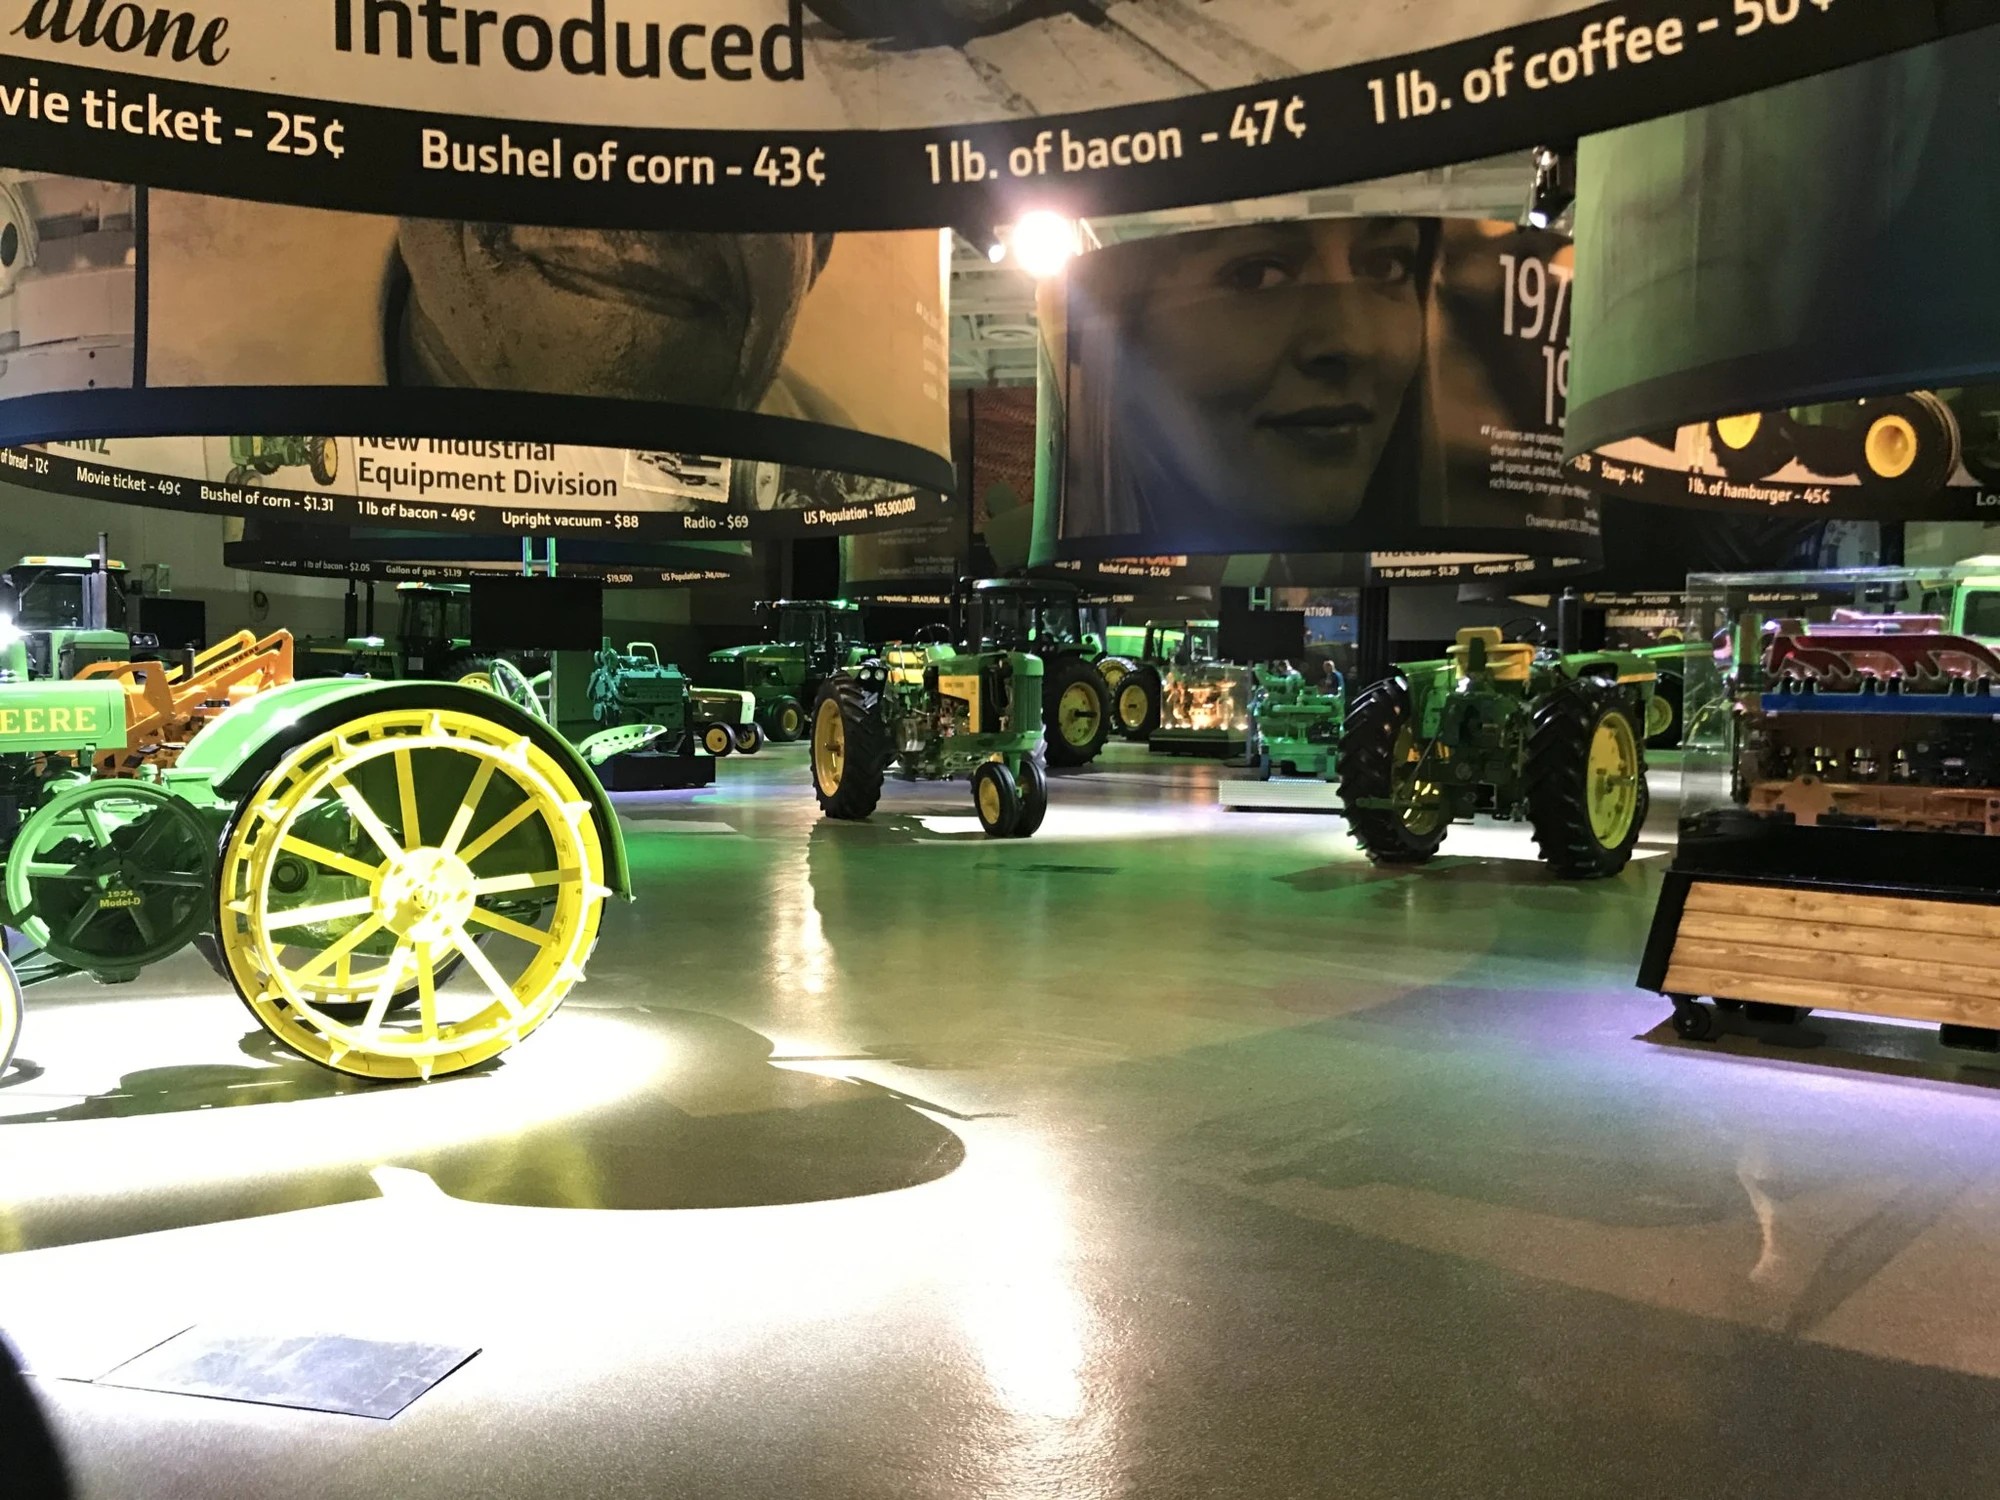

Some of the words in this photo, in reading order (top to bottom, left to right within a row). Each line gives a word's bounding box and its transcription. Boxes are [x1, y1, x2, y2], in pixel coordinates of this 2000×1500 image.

[335, 0, 804, 81] Introduced
[0, 78, 69, 123] vie
[82, 89, 222, 145] ticket
[266, 111, 344, 159] 25¢
[421, 128, 561, 178] Bushel
[572, 140, 618, 182] of
[626, 152, 714, 185] corn
[753, 145, 826, 187] 43¢
[1008, 130, 1052, 178] of
[1061, 126, 1182, 173] bacon
[1229, 95, 1307, 147] 47¢
[1463, 46, 1515, 103] of
[1524, 15, 1684, 89] coffee
[1736, 0, 1834, 37] 50
[1500, 254, 1573, 345] 197
[359, 457, 506, 494] Equipment
[514, 470, 617, 497] Division
[429, 438, 555, 461] Industrial
[1, 448, 8, 464] of
[9, 451, 28, 470] bread
[35, 457, 49, 475] 12¢
[77, 466, 110, 486] Movie
[113, 474, 147, 492] ticket
[157, 479, 181, 496] 49¢
[201, 486, 242, 504] Bushel
[245, 490, 260, 505] of
[263, 495, 291, 508] corn
[304, 495, 333, 512] $1.31
[382, 504, 396, 517] of
[399, 504, 438, 520] bacon
[451, 508, 476, 522] 49¢
[502, 511, 551, 529] Upright
[554, 516, 602, 528] vacuum
[614, 513, 639, 530] $88
[684, 516, 716, 529] Radio
[727, 514, 749, 530] $69
[803, 511, 818, 525] US
[819, 507, 868, 526] Population
[1709, 481, 1722, 496] of
[1724, 481, 1791, 505] hamburger
[1803, 487, 1830, 504] 45¢
[1976, 491, 2000, 506] Lo
[386, 565, 410, 575] Gallon
[422, 569, 436, 578] gas
